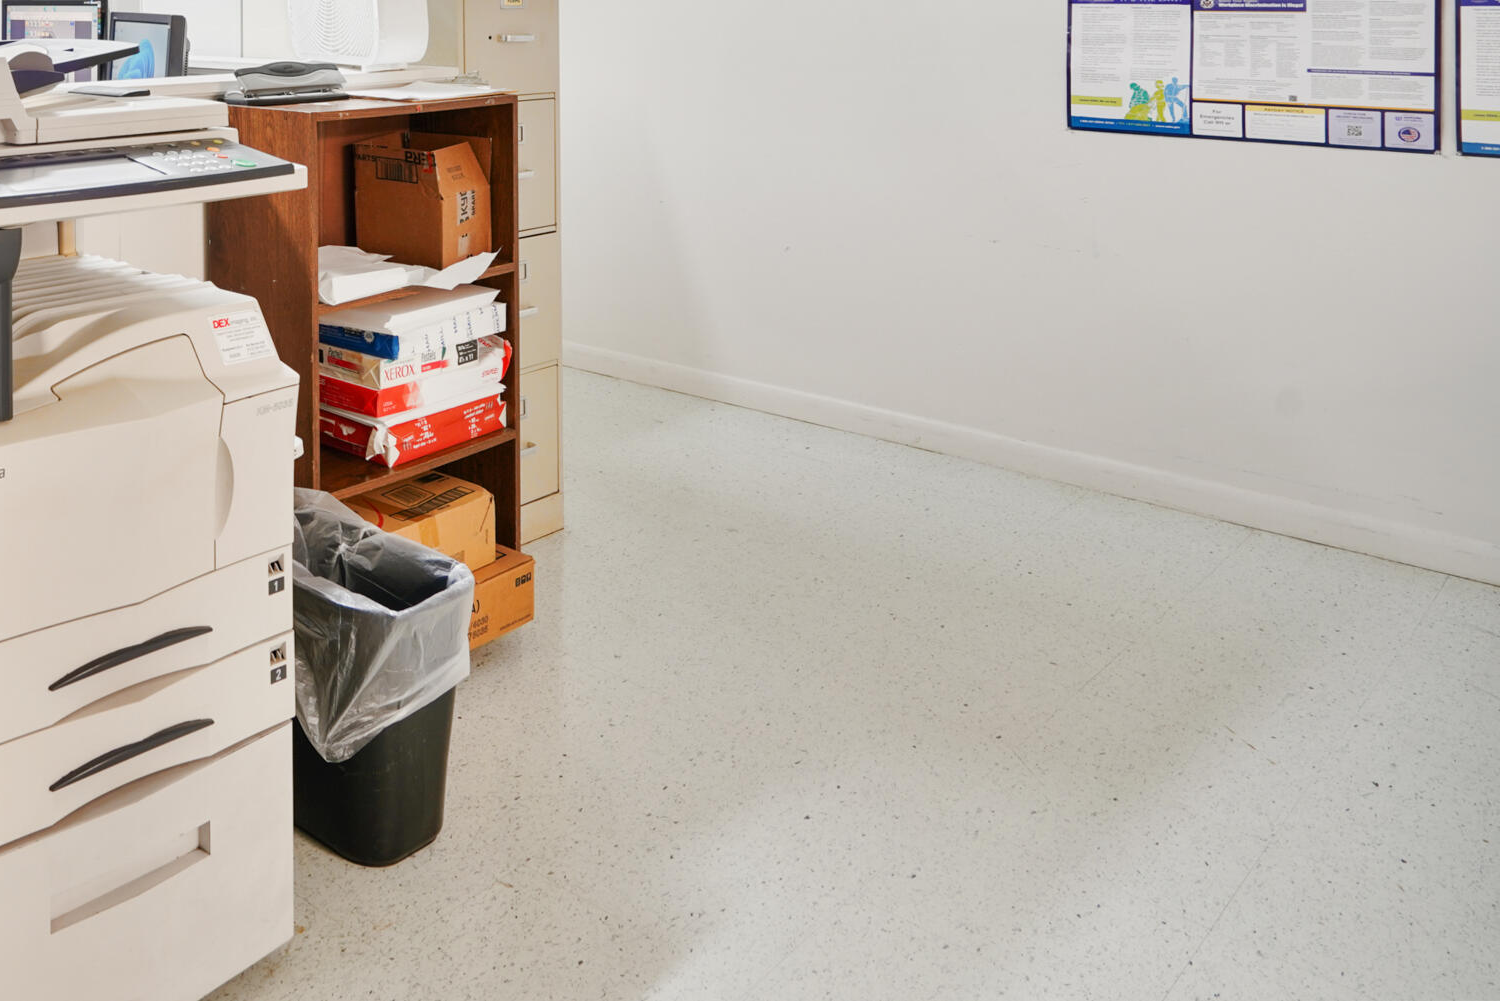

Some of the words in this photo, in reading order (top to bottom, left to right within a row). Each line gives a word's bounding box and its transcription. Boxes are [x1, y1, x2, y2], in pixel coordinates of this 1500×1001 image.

[212, 317, 231, 329] DEX
[383, 364, 416, 381] XEROX
[273, 580, 279, 592] 1
[275, 669, 282, 681] 2
